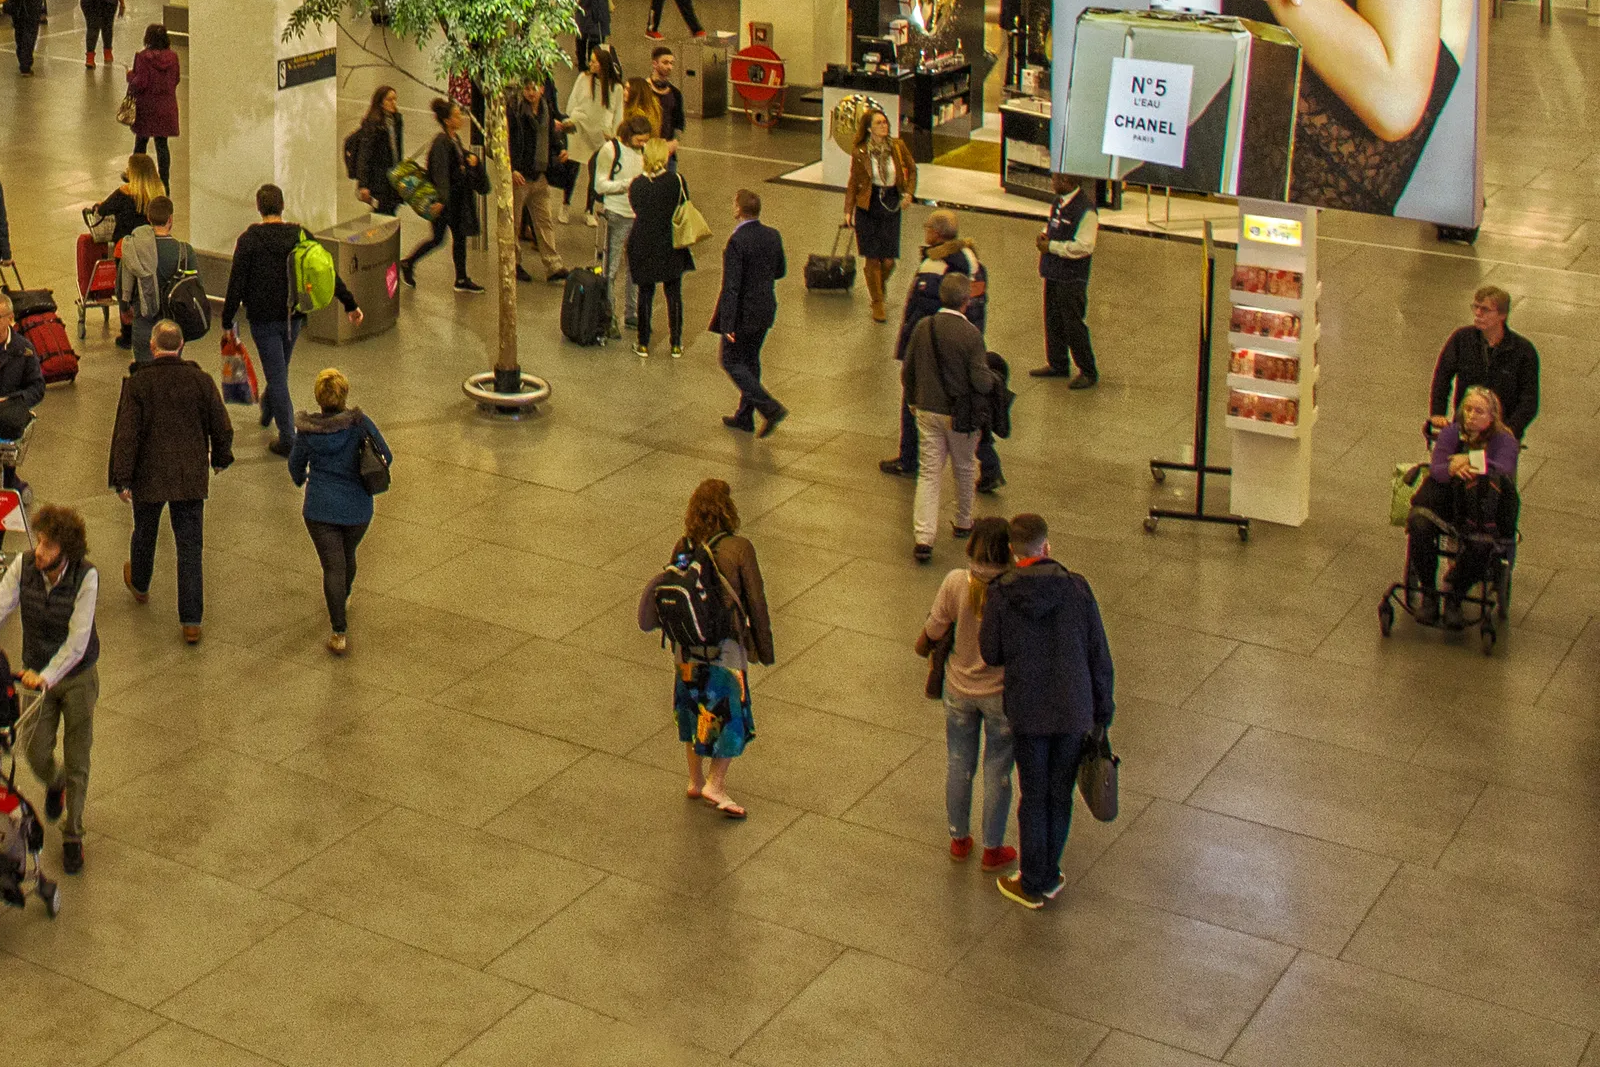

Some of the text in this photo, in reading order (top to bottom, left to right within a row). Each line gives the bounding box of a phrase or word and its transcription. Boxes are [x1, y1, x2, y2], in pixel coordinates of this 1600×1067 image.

[1134, 98, 1161, 109] L'EAU
[1114, 114, 1177, 136] CHANEL
[1133, 135, 1155, 144] PARIS
